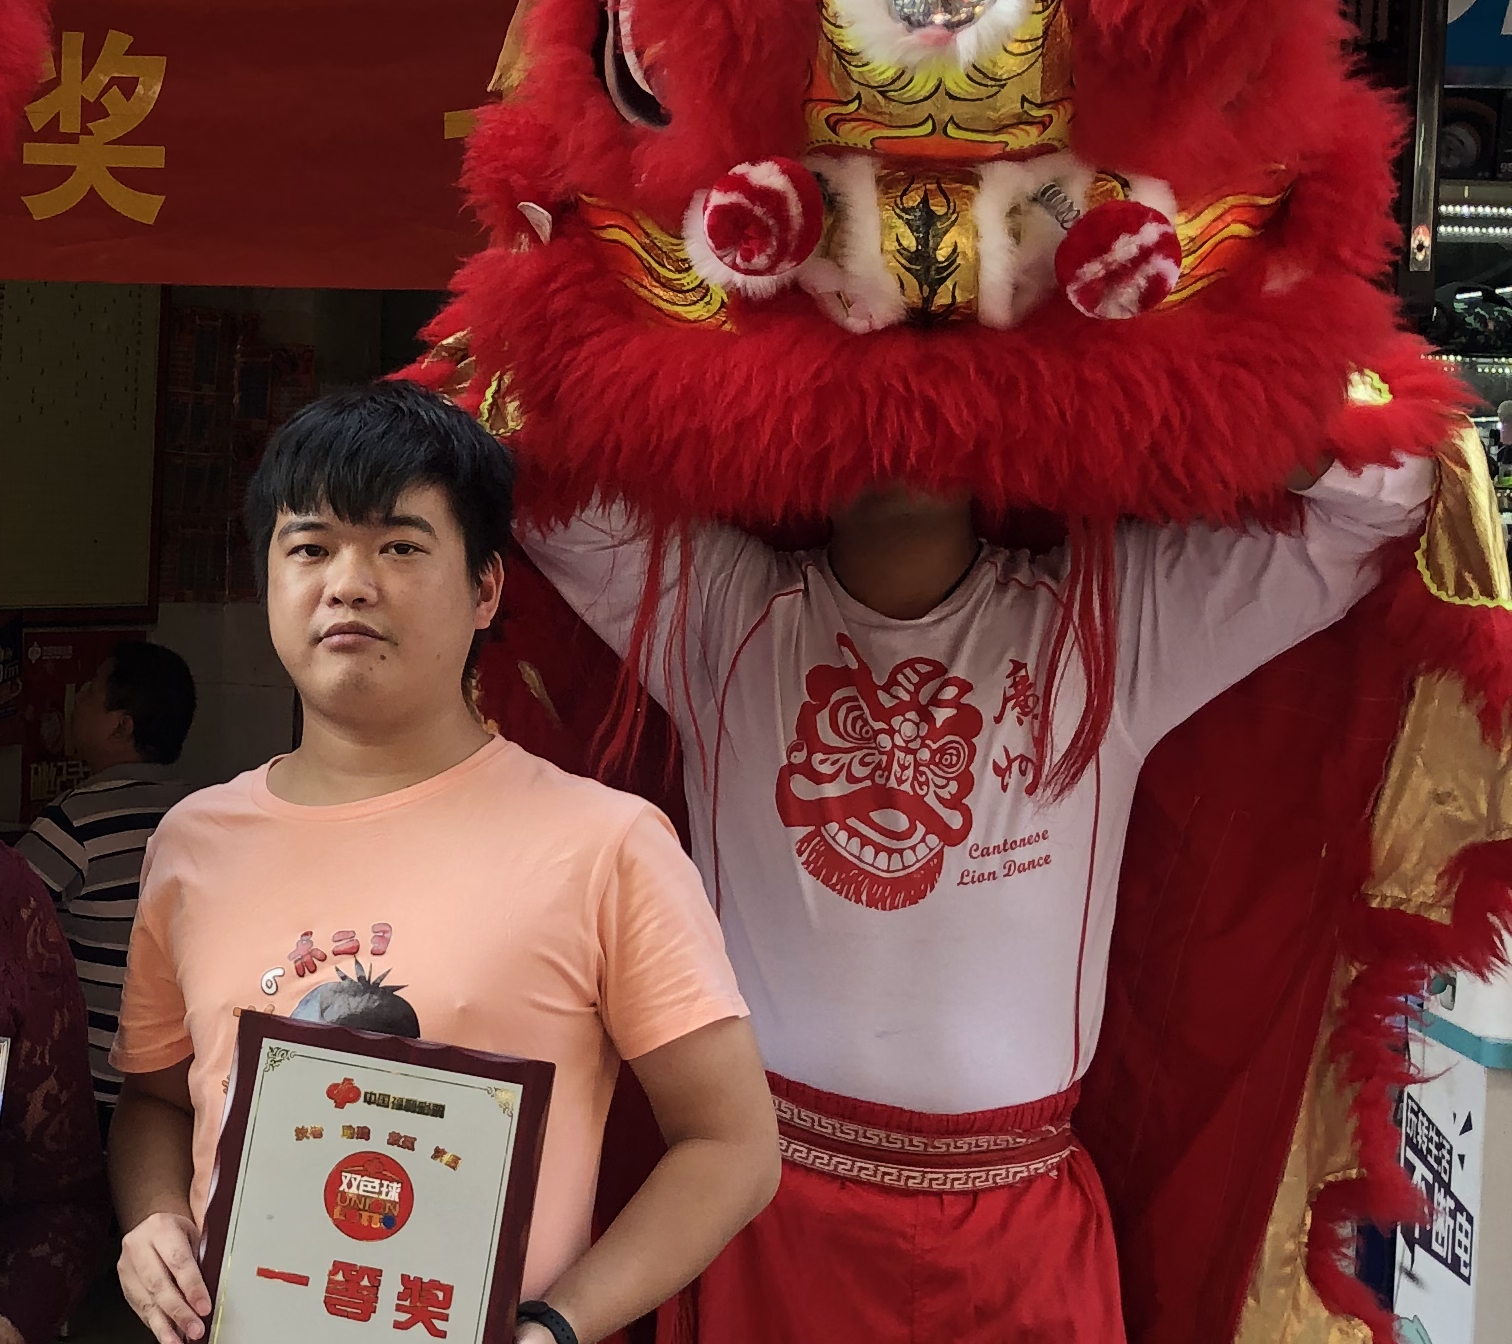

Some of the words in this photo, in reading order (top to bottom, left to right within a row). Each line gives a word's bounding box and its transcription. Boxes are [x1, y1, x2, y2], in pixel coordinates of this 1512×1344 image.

[968, 828, 1050, 860] Cantonese
[956, 868, 998, 887] Lion
[1002, 854, 1052, 878] Dance
[1406, 1098, 1451, 1185] 玩转生活
[338, 1172, 402, 1202] 双色球
[255, 1259, 455, 1340] 一等奖
